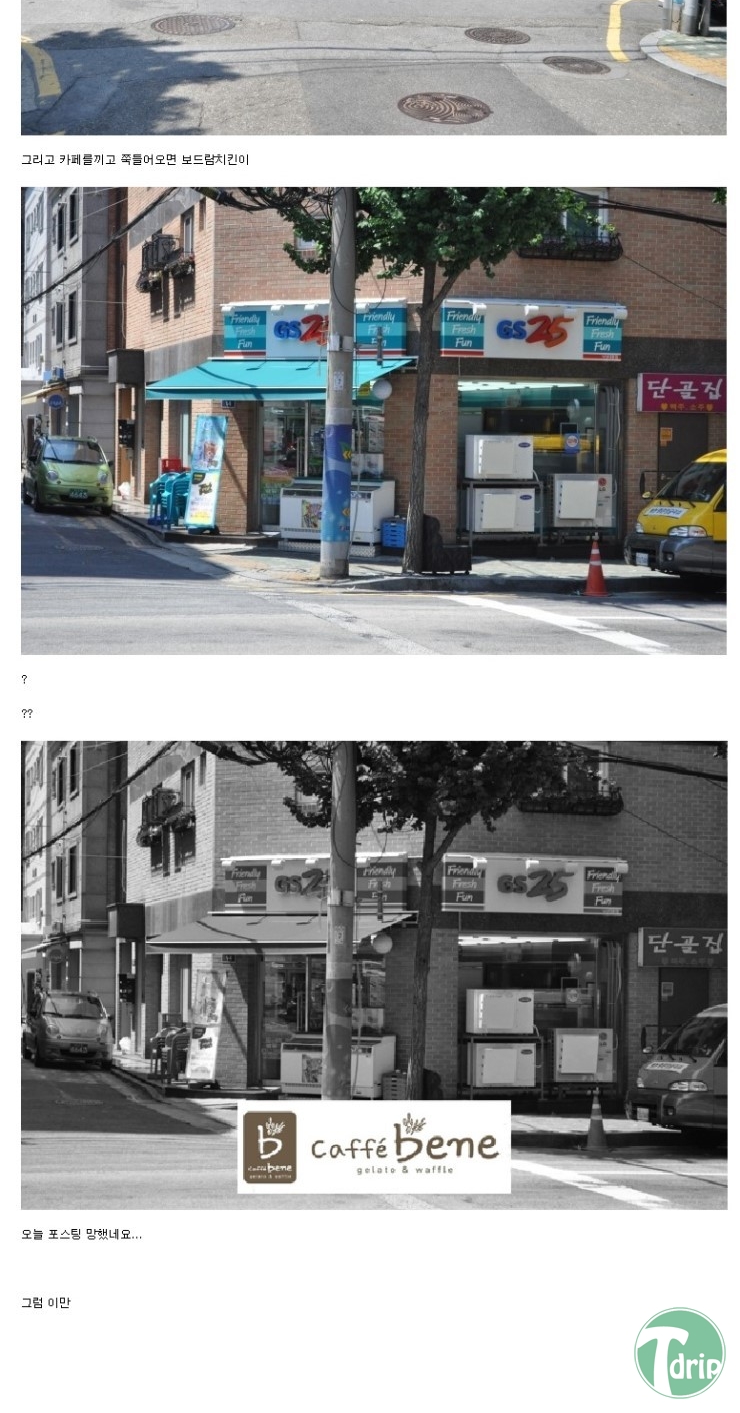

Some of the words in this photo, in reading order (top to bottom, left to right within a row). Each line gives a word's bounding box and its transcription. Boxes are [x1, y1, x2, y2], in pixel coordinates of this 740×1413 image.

[231, 314, 260, 326] Friendly
[363, 312, 396, 325] Friendly
[447, 310, 482, 323] Friendly
[586, 315, 620, 328] Friendly
[236, 328, 256, 337] Fresh
[453, 325, 476, 335] Fresh
[496, 315, 574, 348] GS25
[592, 329, 614, 339] Fresh
[238, 340, 252, 349] Fun
[456, 338, 472, 348] Fun
[594, 341, 611, 352] Fun
[647, 377, 724, 400] 단골집
[231, 868, 261, 879] Friendly
[363, 866, 396, 878] Friendly
[447, 865, 482, 878] Friendly
[587, 870, 621, 883] Friendly
[453, 880, 477, 889] Fresh
[497, 870, 574, 902] GS25
[592, 882, 615, 894] Fresh
[238, 894, 253, 903] Fun
[456, 892, 473, 902] Fun
[595, 896, 612, 906] Fun
[648, 931, 724, 955] 단골집
